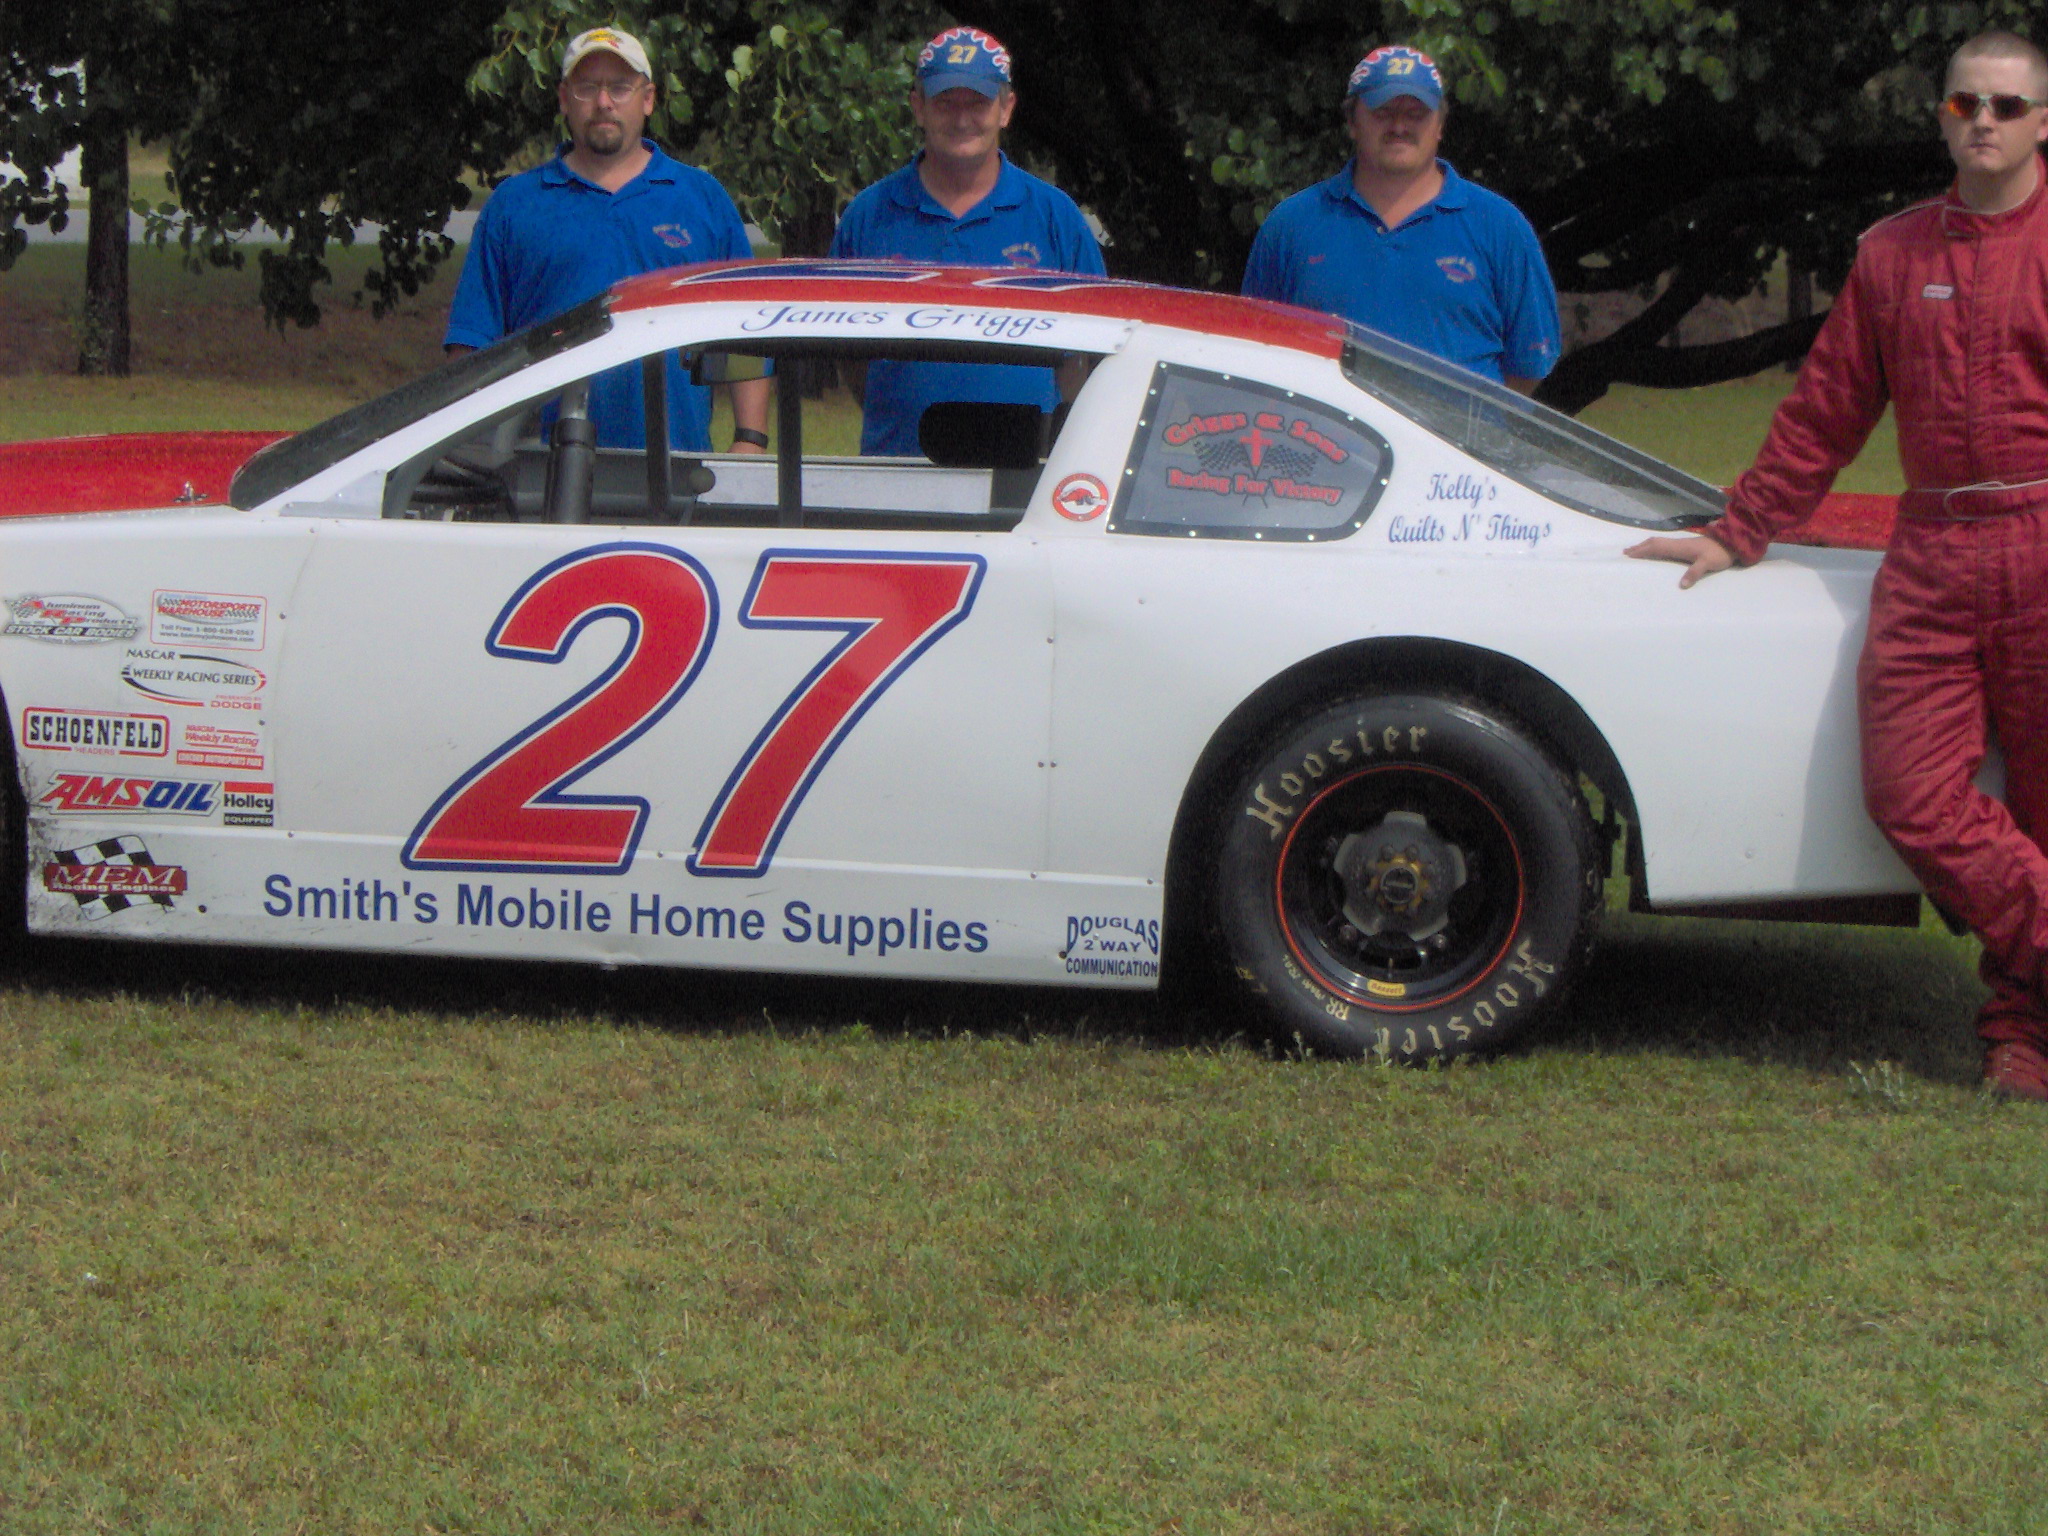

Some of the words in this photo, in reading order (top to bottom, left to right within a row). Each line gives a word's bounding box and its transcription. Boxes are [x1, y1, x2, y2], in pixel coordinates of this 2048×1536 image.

[947, 45, 977, 63] 27
[1387, 58, 1415, 75] 27
[741, 305, 888, 331] James
[905, 307, 1058, 337] Griggs
[1163, 412, 1248, 446] Griggs
[1254, 412, 1284, 432] &
[1288, 419, 1349, 463] Sons
[1166, 467, 1231, 495] Racing
[1233, 473, 1270, 496] For
[1270, 477, 1344, 506] Victory
[1426, 473, 1497, 508] Kelly's
[1388, 516, 1445, 543] Quilts
[1485, 513, 1551, 547] Things
[158, 606, 225, 618] WAREHOUSE
[180, 599, 262, 612] MOTORSPORTS
[5, 625, 51, 636] STOCK
[53, 626, 84, 636] CAR
[85, 628, 137, 639] BODIES
[126, 649, 175, 660] NASCAR
[133, 668, 174, 681] WEEKLY
[177, 671, 220, 683] RACING
[223, 674, 257, 686] SERIES
[211, 700, 262, 711] DODGE
[399, 541, 988, 878] 27
[30, 715, 162, 749] SCHOENFELD
[185, 732, 221, 744] Weekly
[223, 735, 260, 748] Racing
[1246, 725, 1428, 841] Hoosier
[40, 774, 214, 811] AMSOIL
[224, 794, 274, 812] Holley
[52, 866, 177, 884] MEM
[52, 881, 108, 892] Racing
[111, 883, 177, 892] Engines
[263, 874, 438, 924] Smith's
[457, 883, 612, 932] Mobile
[630, 893, 765, 940] Home
[782, 900, 989, 956] Supplies
[1066, 916, 1158, 955] DOUGLAS
[1084, 940, 1094, 951] 2
[1100, 941, 1141, 952] WAY
[1066, 958, 1158, 977] COMMUNICATION
